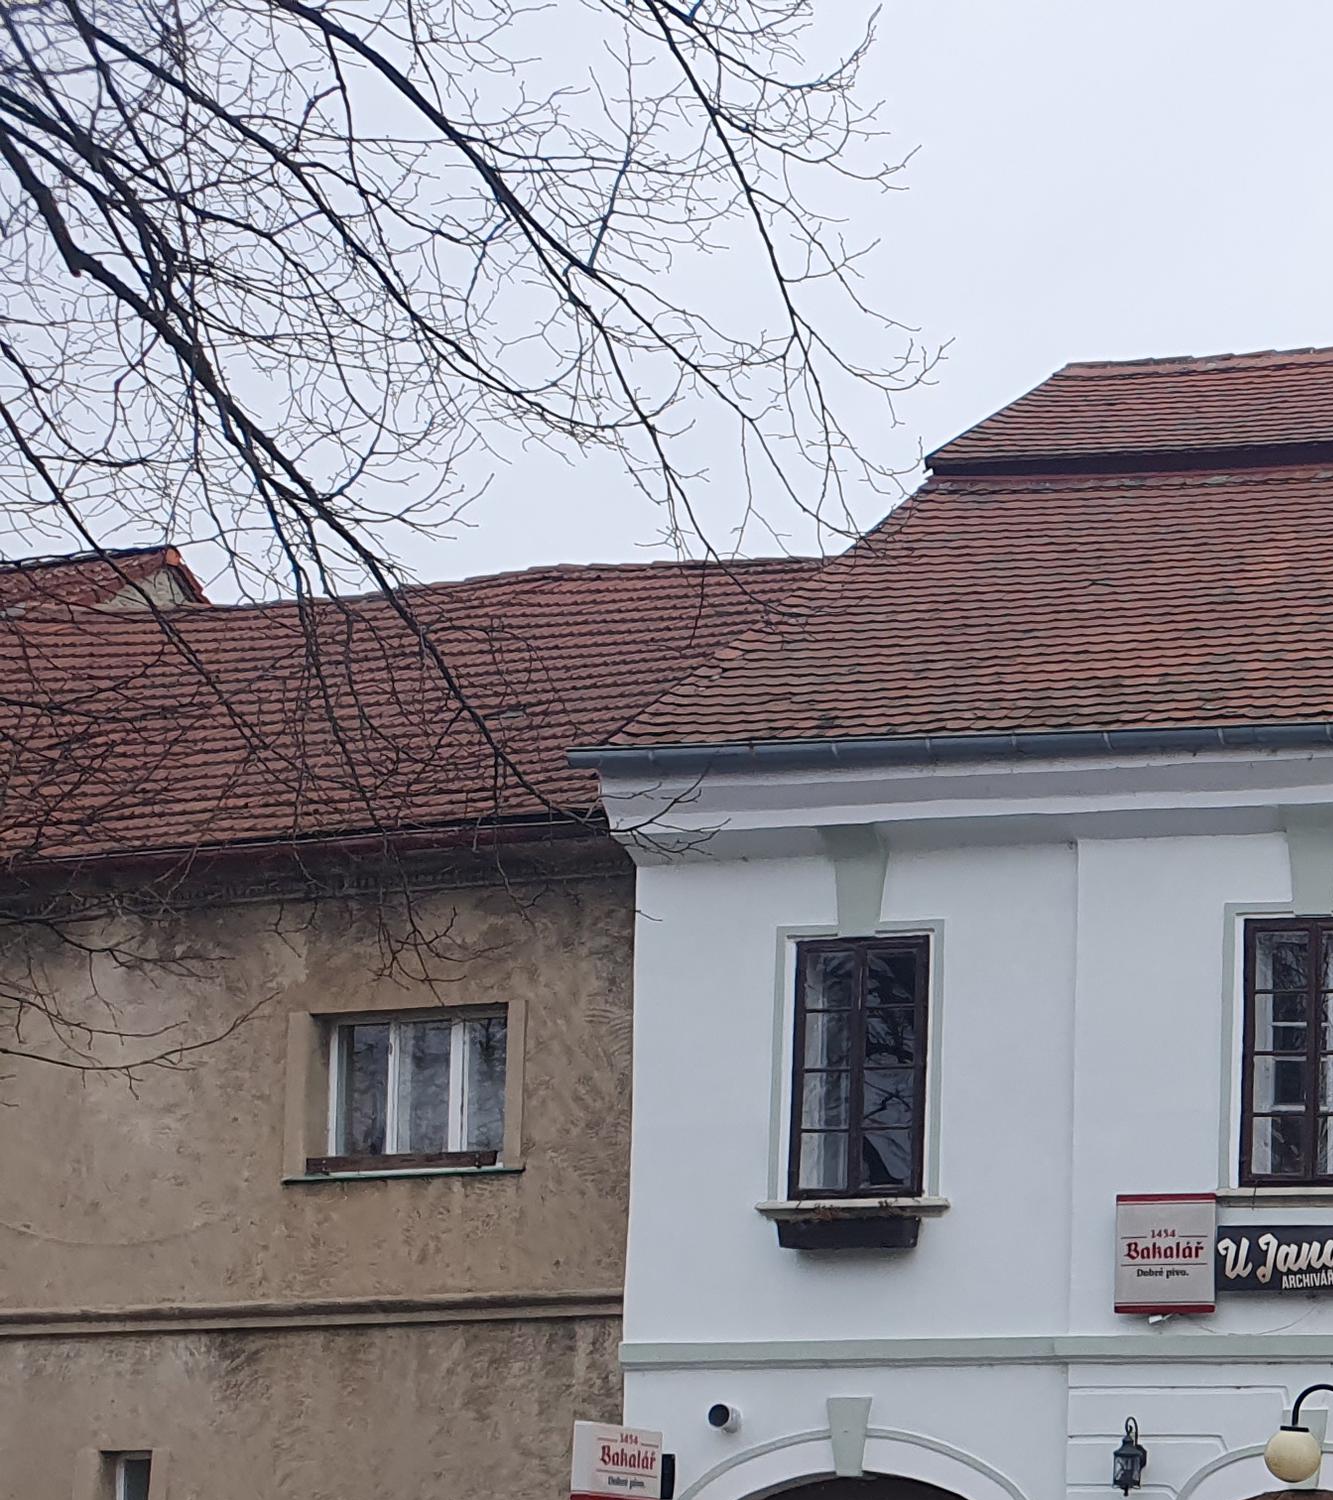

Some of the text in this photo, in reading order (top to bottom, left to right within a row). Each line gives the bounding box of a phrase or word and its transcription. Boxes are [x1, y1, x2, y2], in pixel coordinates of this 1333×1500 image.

[1124, 1241, 1204, 1260] Bakalář
[1217, 1237, 1253, 1280] U
[600, 1445, 656, 1470] Bakalář
